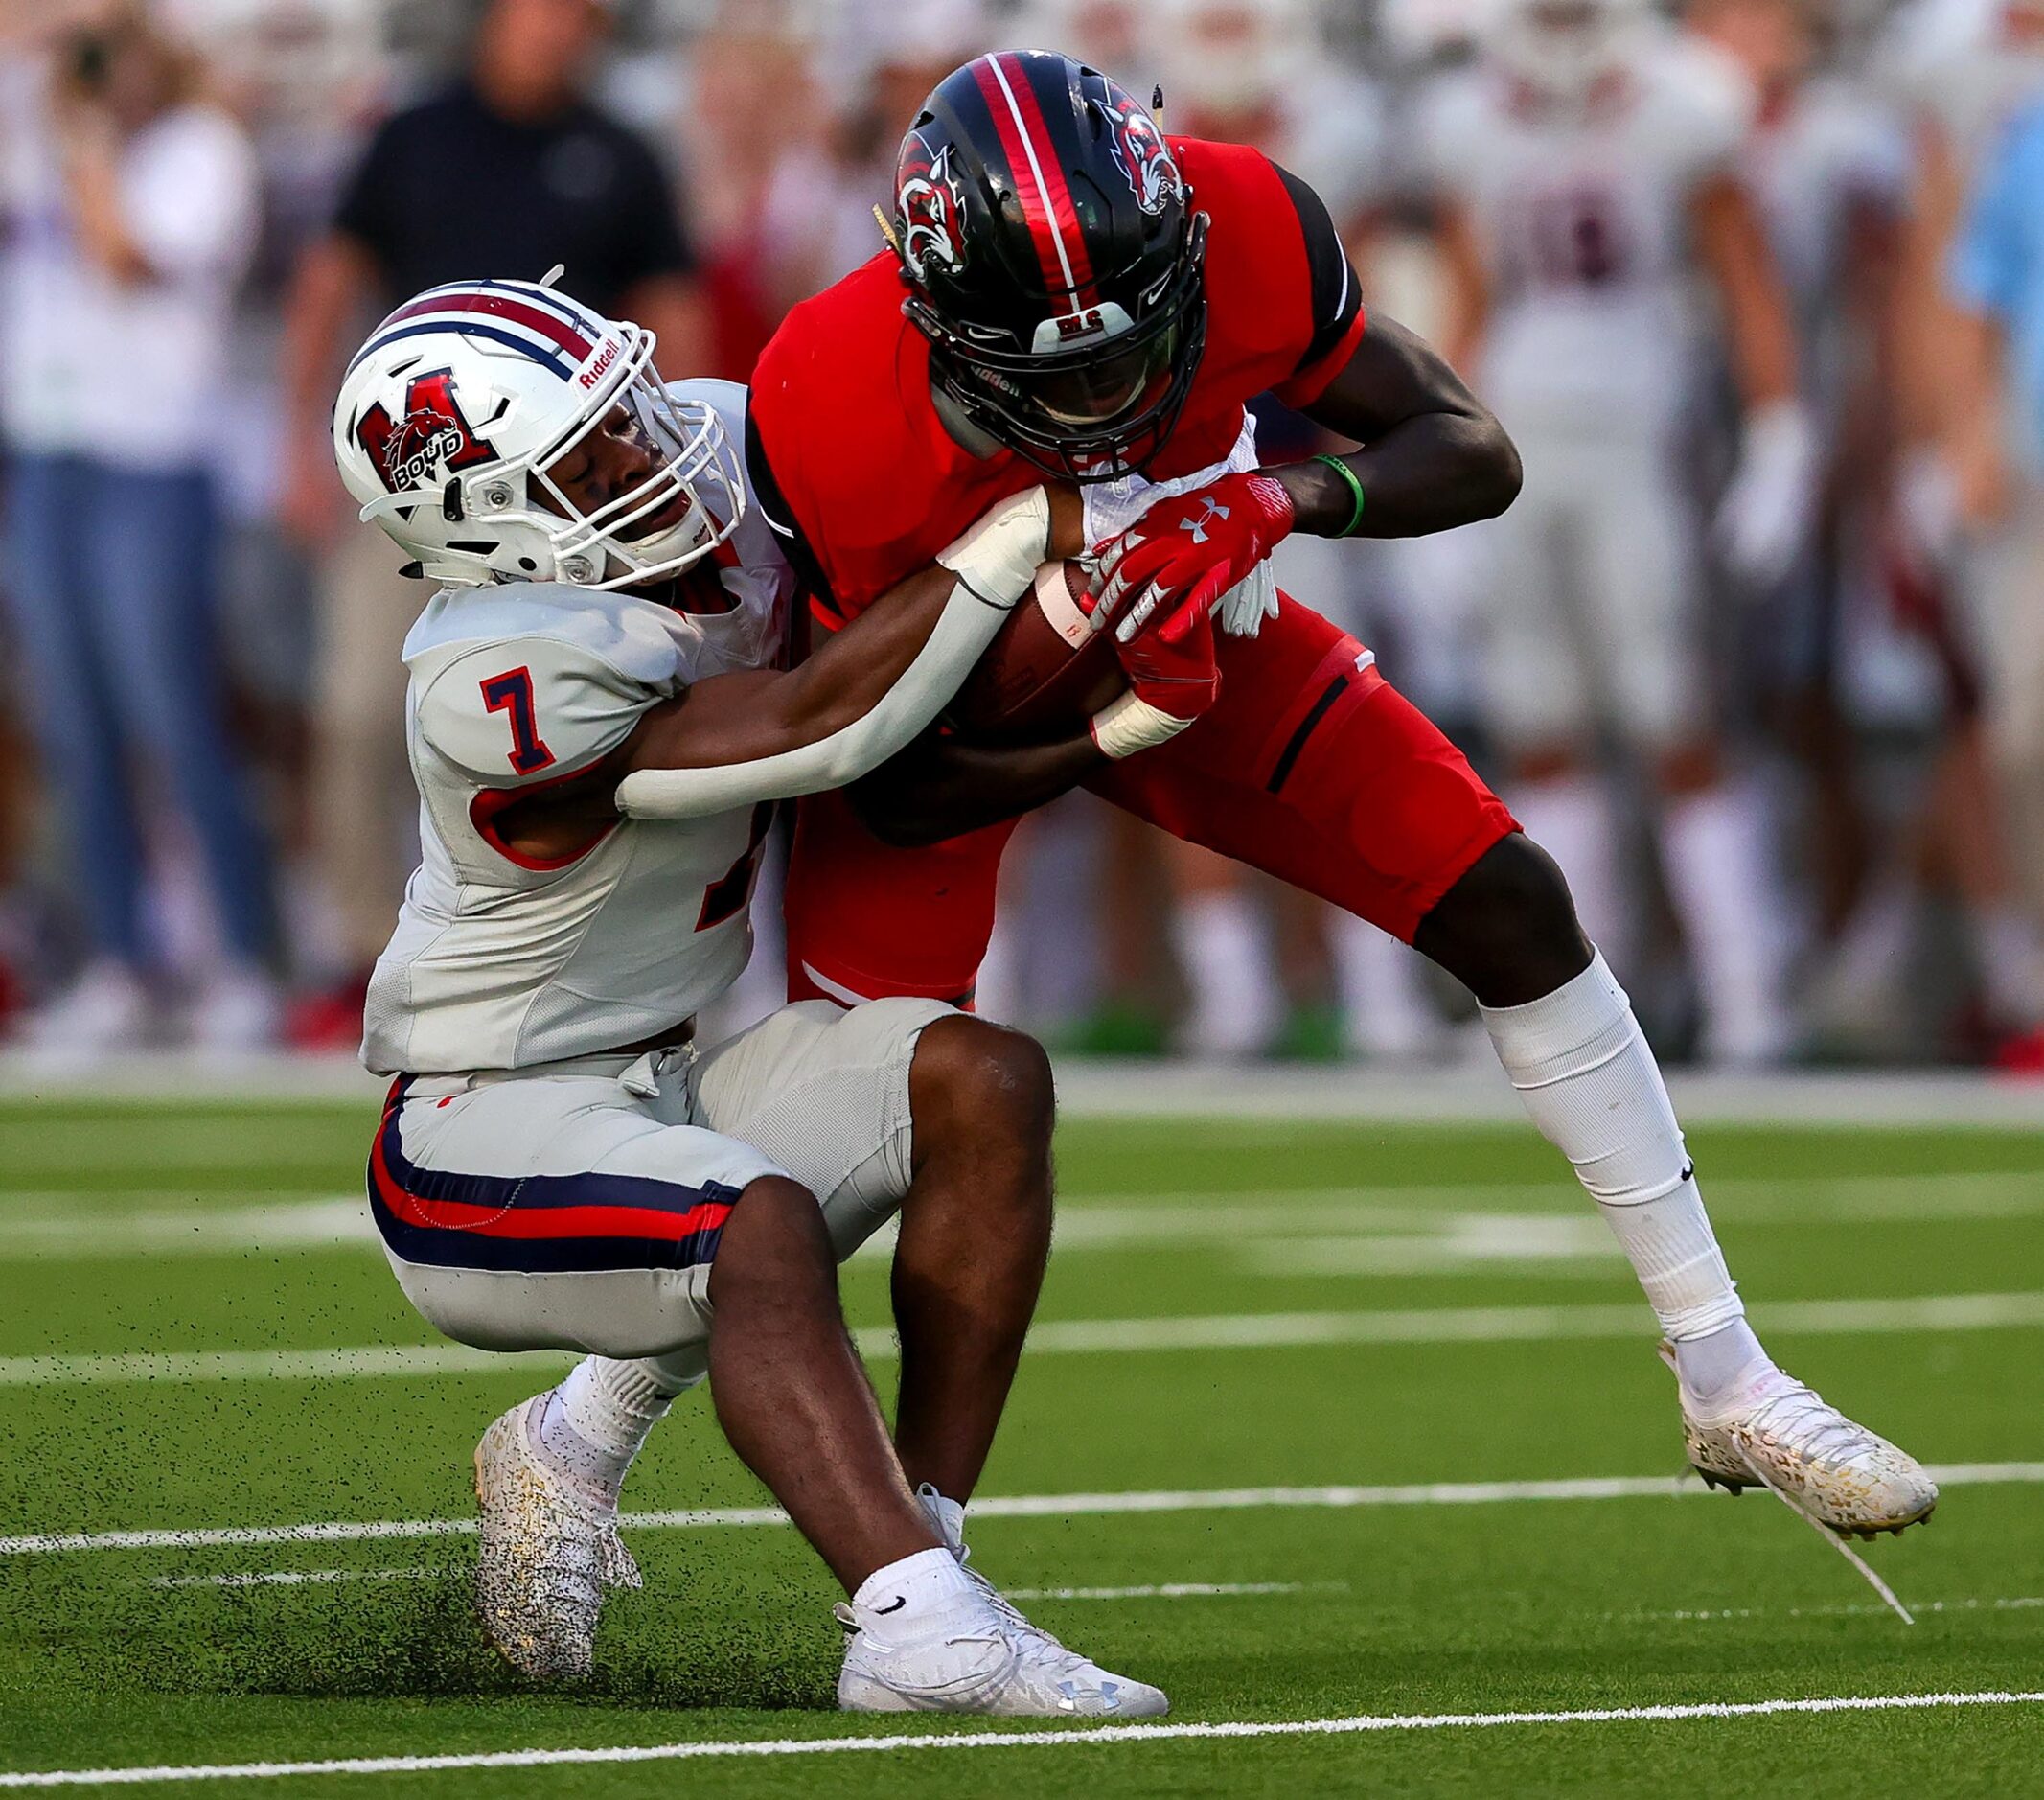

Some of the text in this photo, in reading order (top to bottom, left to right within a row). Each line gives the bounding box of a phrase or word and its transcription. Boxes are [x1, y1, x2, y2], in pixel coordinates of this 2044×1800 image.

[579, 338, 619, 390] Riddell
[391, 429, 464, 492] BOYD
[479, 665, 557, 775] 7
